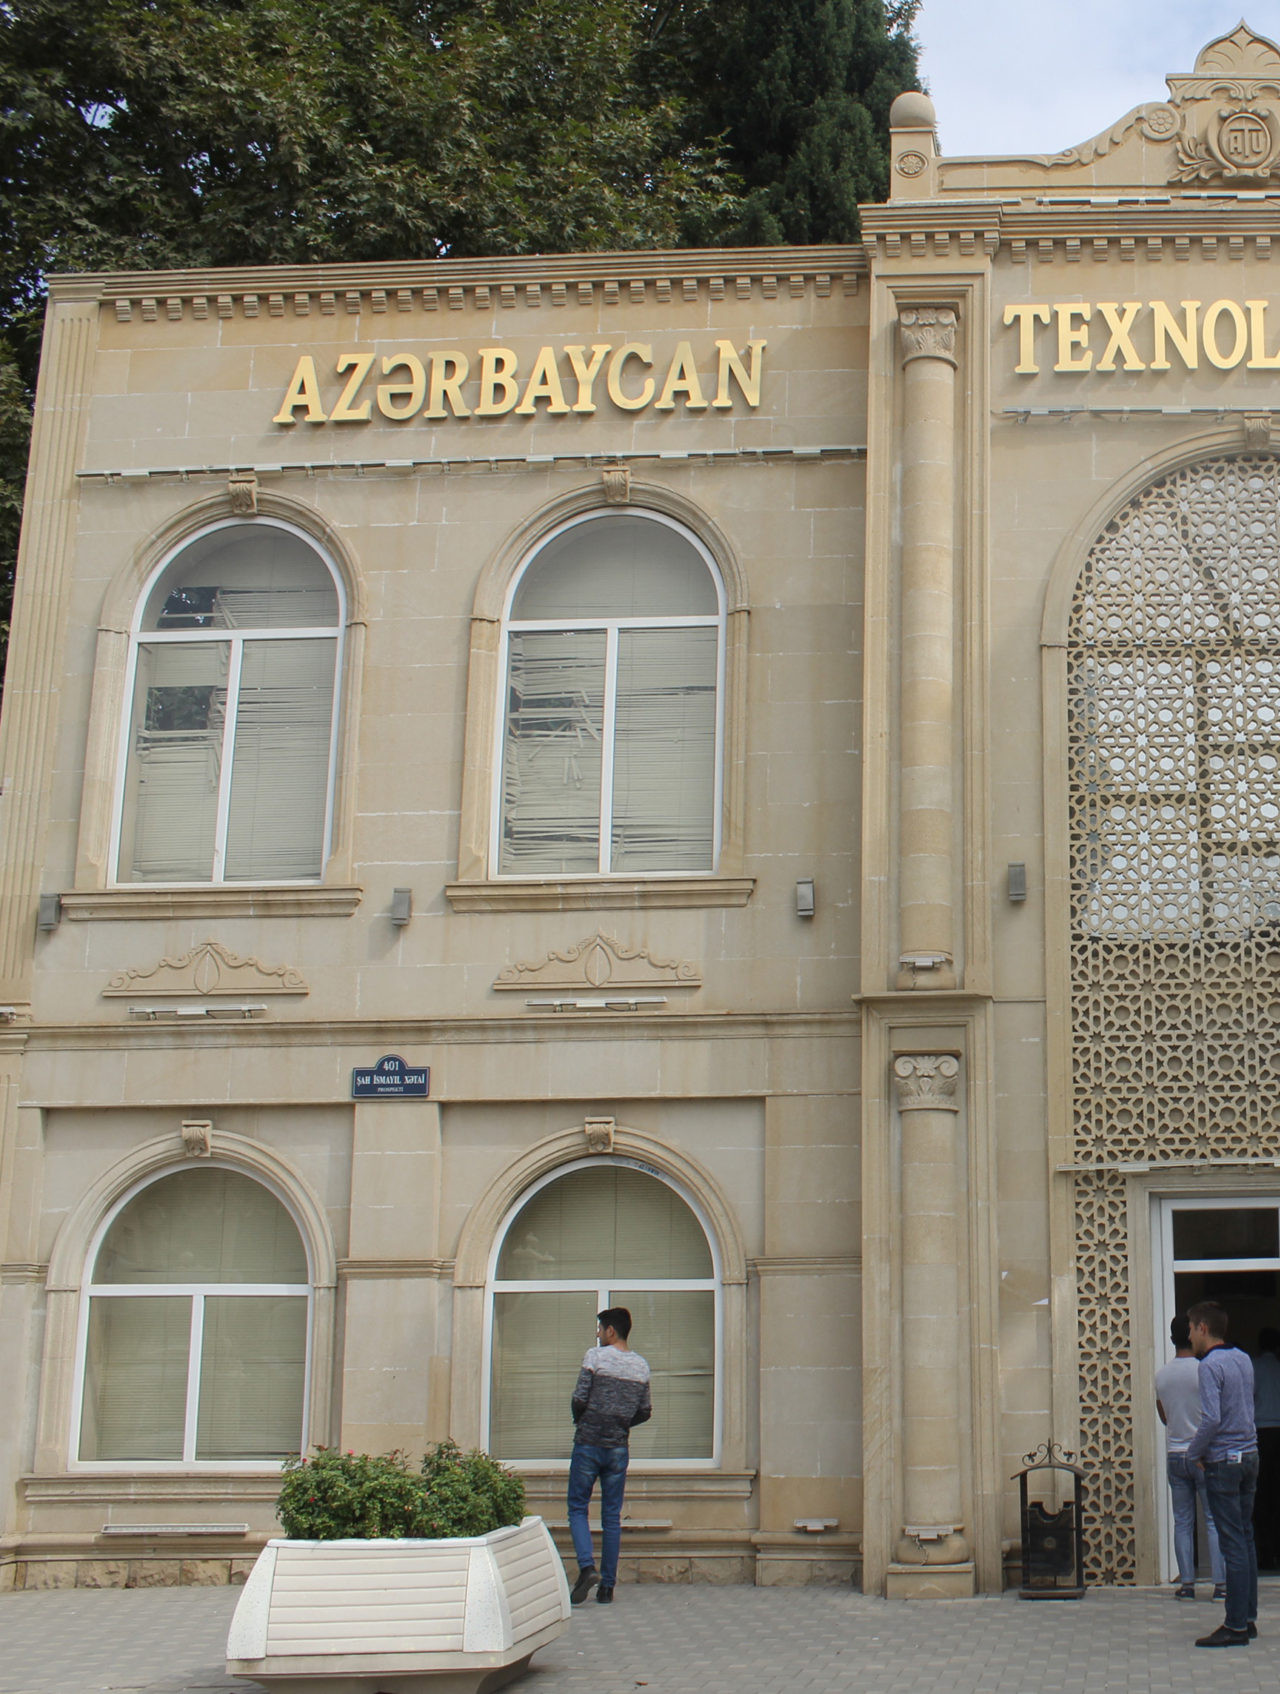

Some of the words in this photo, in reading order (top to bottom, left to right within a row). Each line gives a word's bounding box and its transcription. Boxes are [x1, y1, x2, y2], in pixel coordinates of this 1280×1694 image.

[272, 339, 768, 425] AZƏRBAYCAN
[383, 1060, 399, 1071] 401
[356, 1075, 371, 1087] ŞAH
[373, 1074, 402, 1085] İSMAYIL
